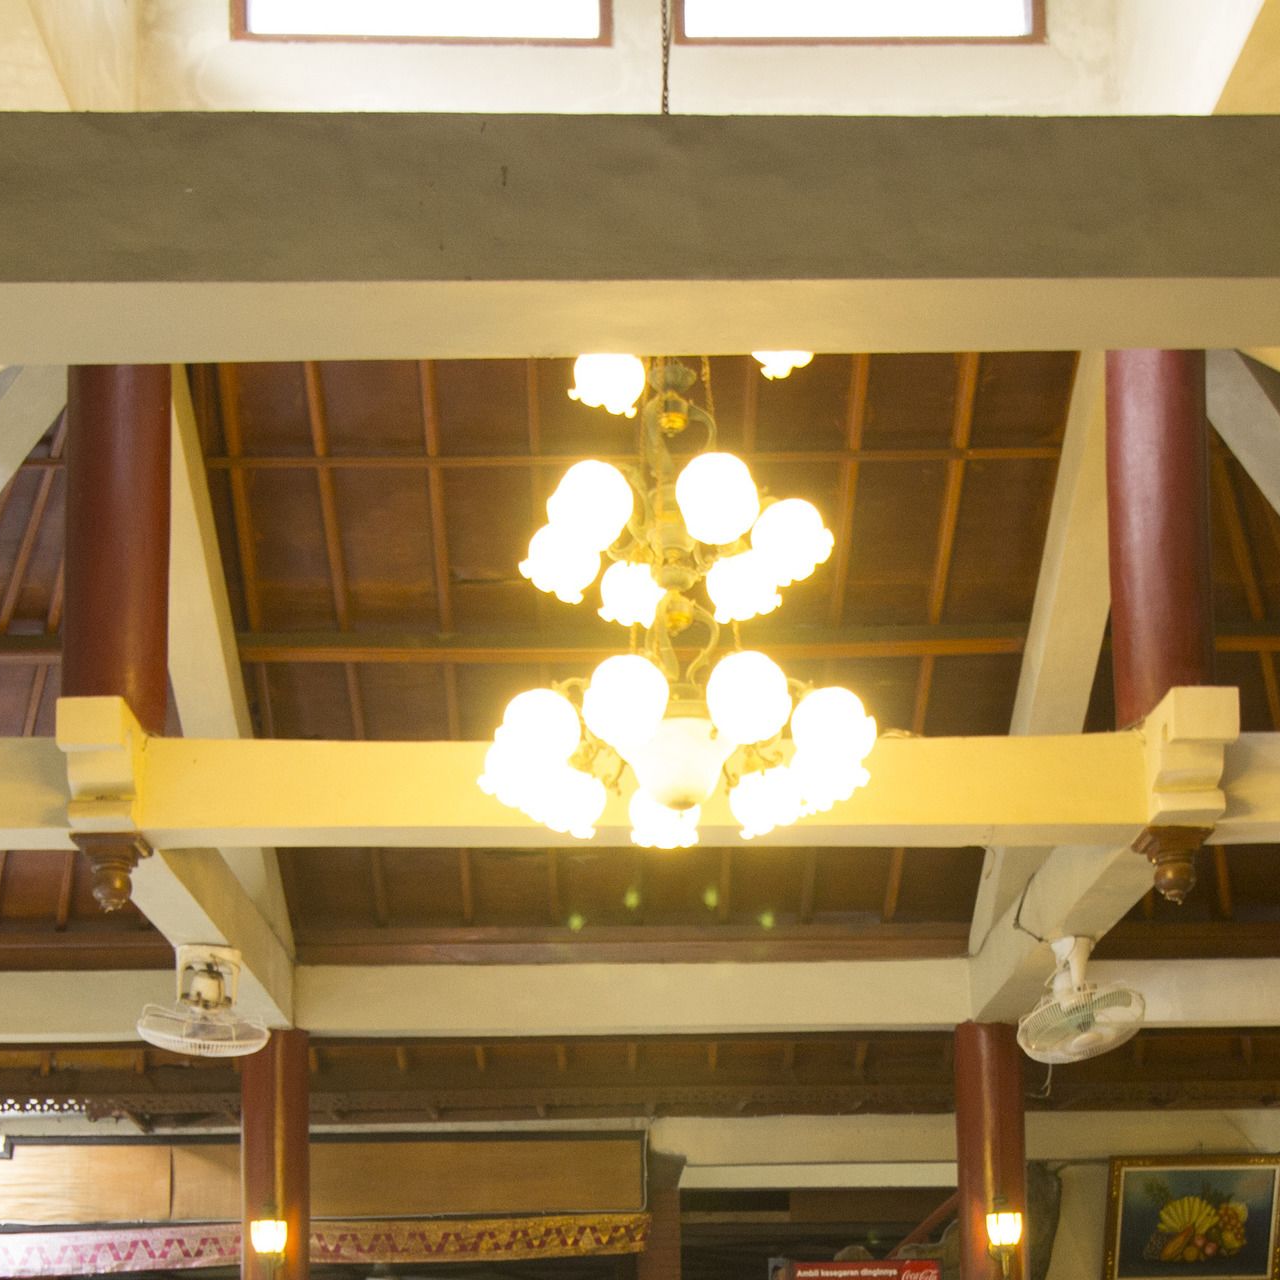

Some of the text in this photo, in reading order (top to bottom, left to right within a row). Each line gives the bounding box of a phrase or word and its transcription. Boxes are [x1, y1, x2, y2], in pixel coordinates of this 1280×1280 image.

[796, 1268, 898, 1278] Ambil kesegaran dinginnya
